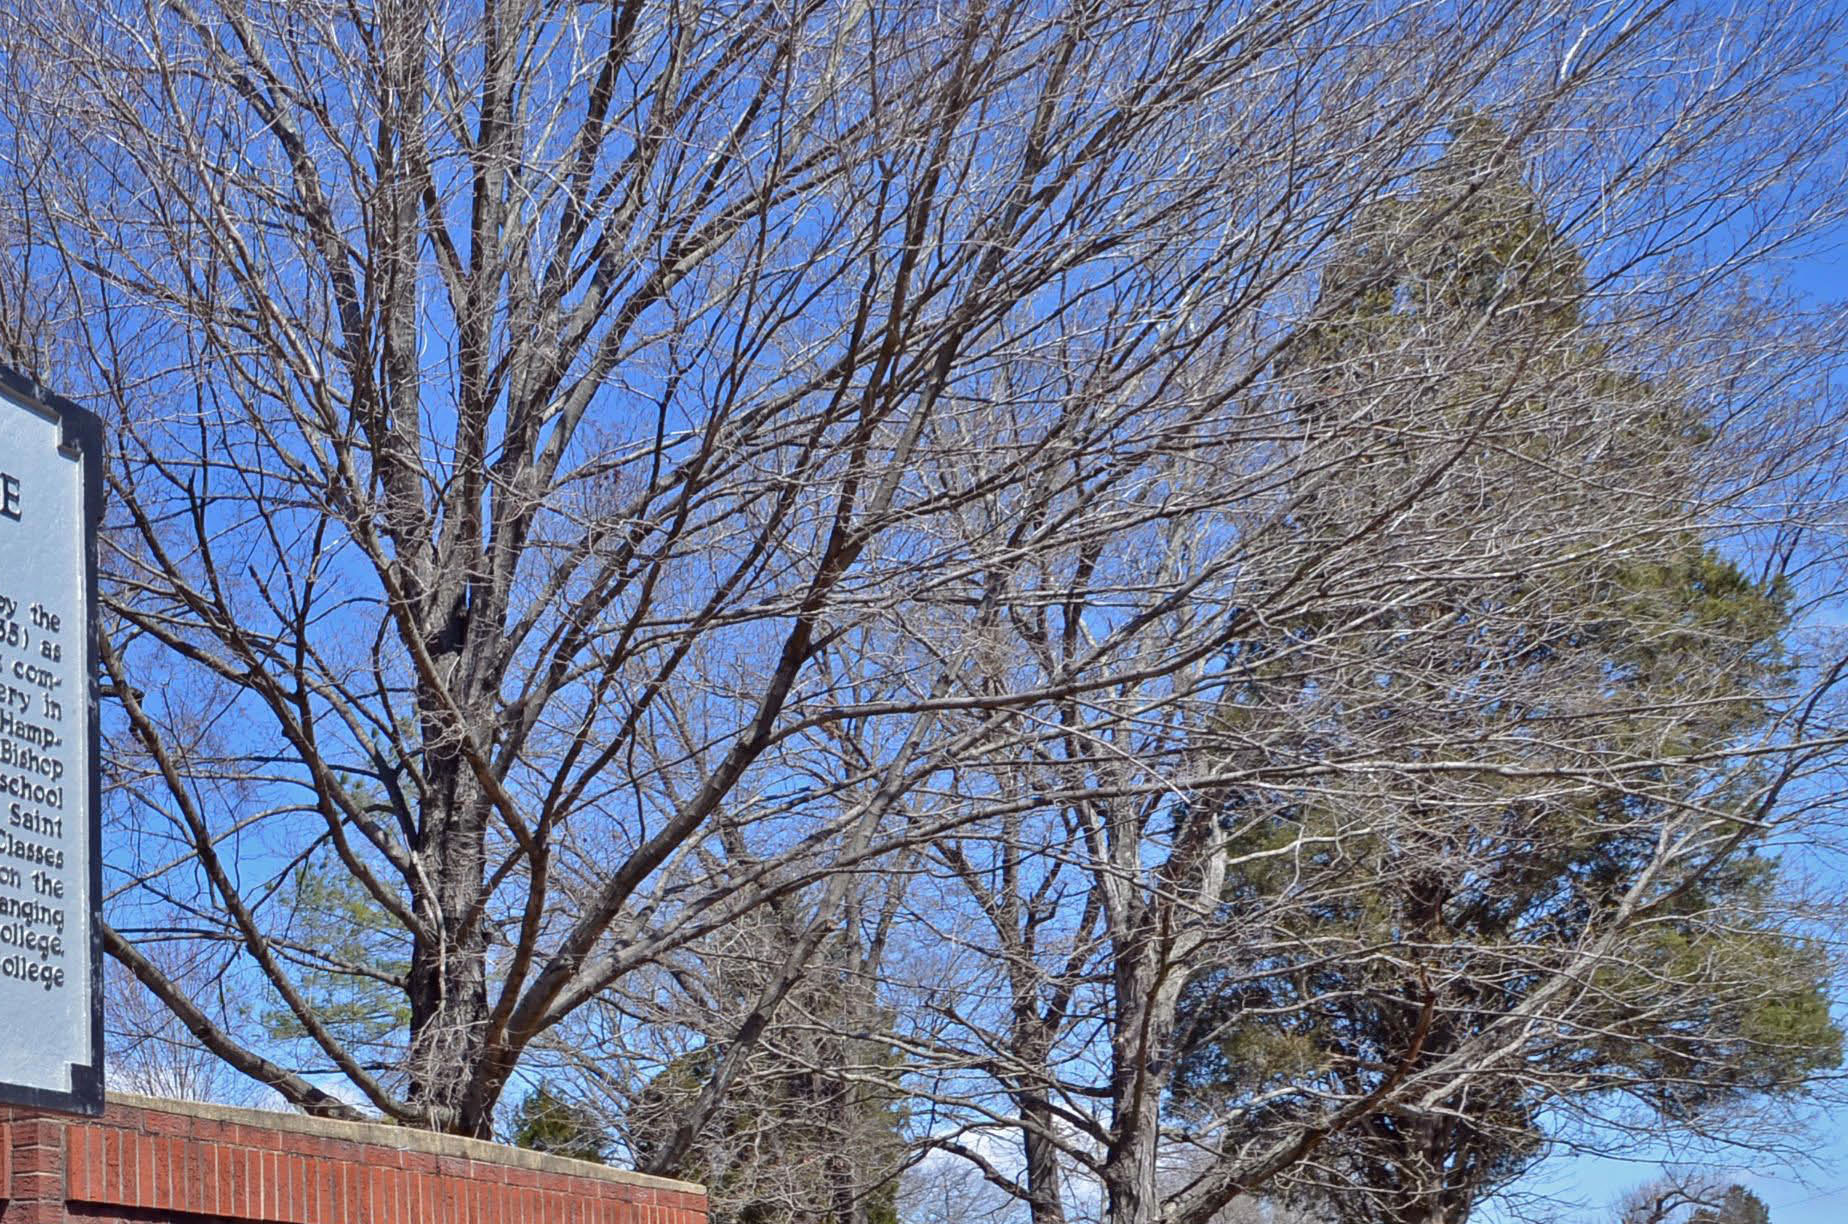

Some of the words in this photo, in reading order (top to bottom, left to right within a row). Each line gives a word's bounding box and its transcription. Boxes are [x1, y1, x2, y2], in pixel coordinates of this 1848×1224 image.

[29, 603, 61, 634] the
[40, 639, 62, 664] as
[12, 660, 62, 692] com-
[43, 692, 62, 722] in
[0, 738, 64, 783] Bishop
[9, 802, 63, 839] Saint
[31, 870, 64, 900] the
